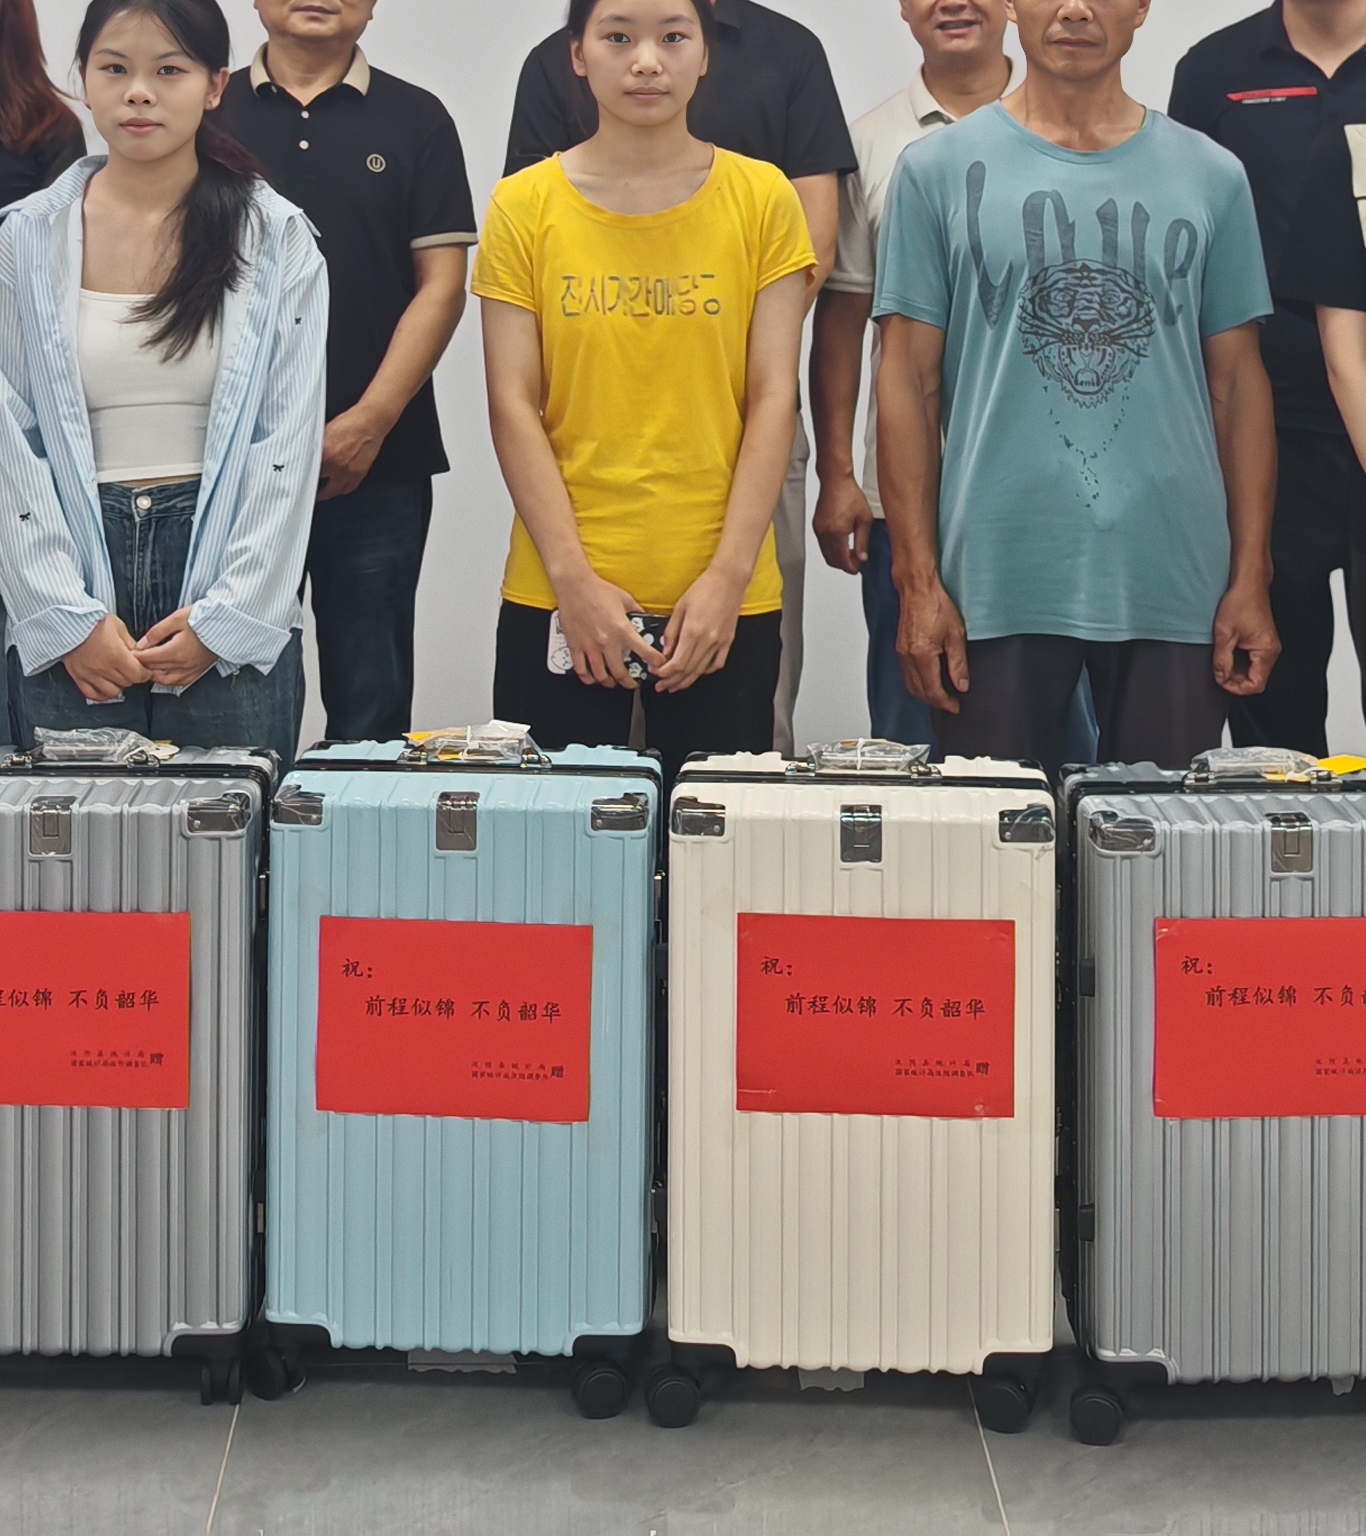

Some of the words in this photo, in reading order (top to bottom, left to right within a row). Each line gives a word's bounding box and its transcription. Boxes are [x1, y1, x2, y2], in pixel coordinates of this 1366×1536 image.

[68, 988, 160, 1012] 不负韶华
[364, 994, 455, 1020] 前程似锦
[470, 999, 562, 1024] 不负韶华
[784, 992, 877, 1018] 前程似锦
[892, 996, 986, 1021] 不负韶华
[1205, 985, 1297, 1008] 前程似锦
